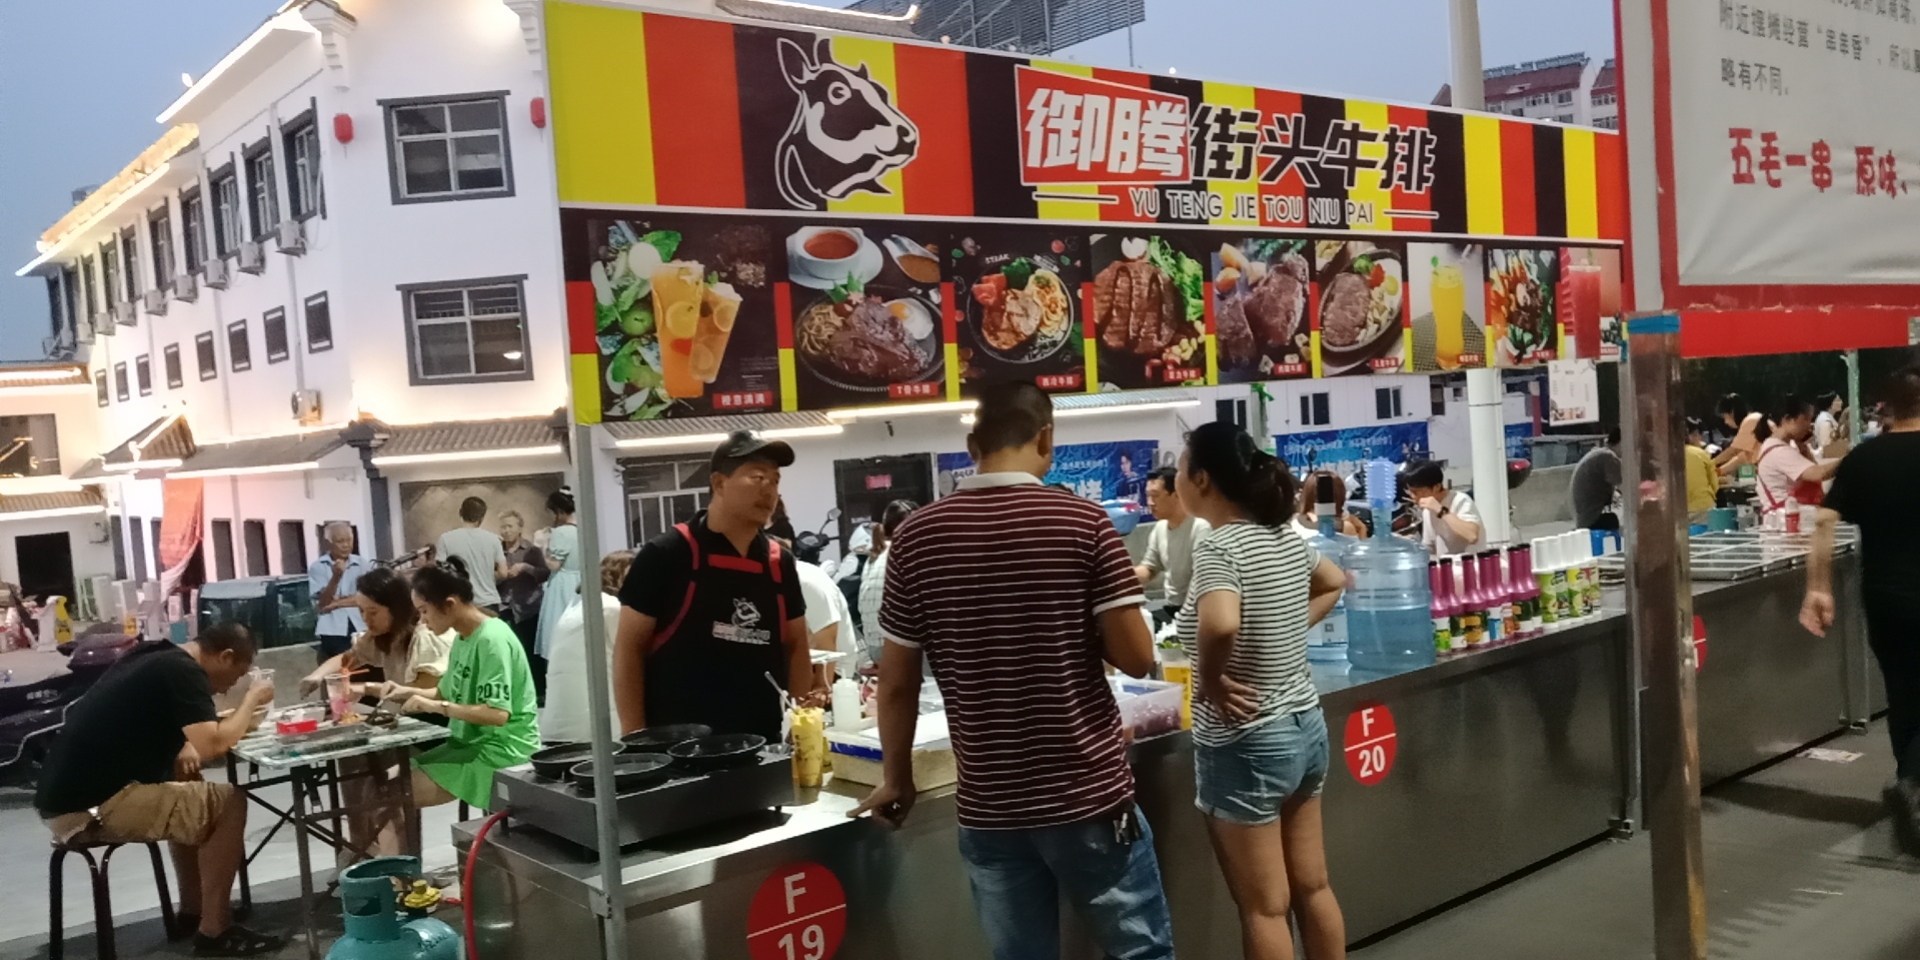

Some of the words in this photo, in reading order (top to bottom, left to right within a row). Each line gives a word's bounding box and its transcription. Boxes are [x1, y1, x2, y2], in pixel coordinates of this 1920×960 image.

[1728, 127, 1833, 193] 五毛一串
[1129, 188, 1159, 218] YU
[1166, 190, 1223, 219] TENG
[1231, 194, 1257, 219] JIE
[1262, 195, 1303, 223] TOU
[1308, 197, 1340, 225] NIU
[1345, 199, 1374, 225] PAI
[897, 384, 931, 396] T骨牛排
[1361, 707, 1375, 738] F
[1358, 745, 1386, 779] 20
[784, 872, 807, 915] F
[778, 924, 825, 960] 19
